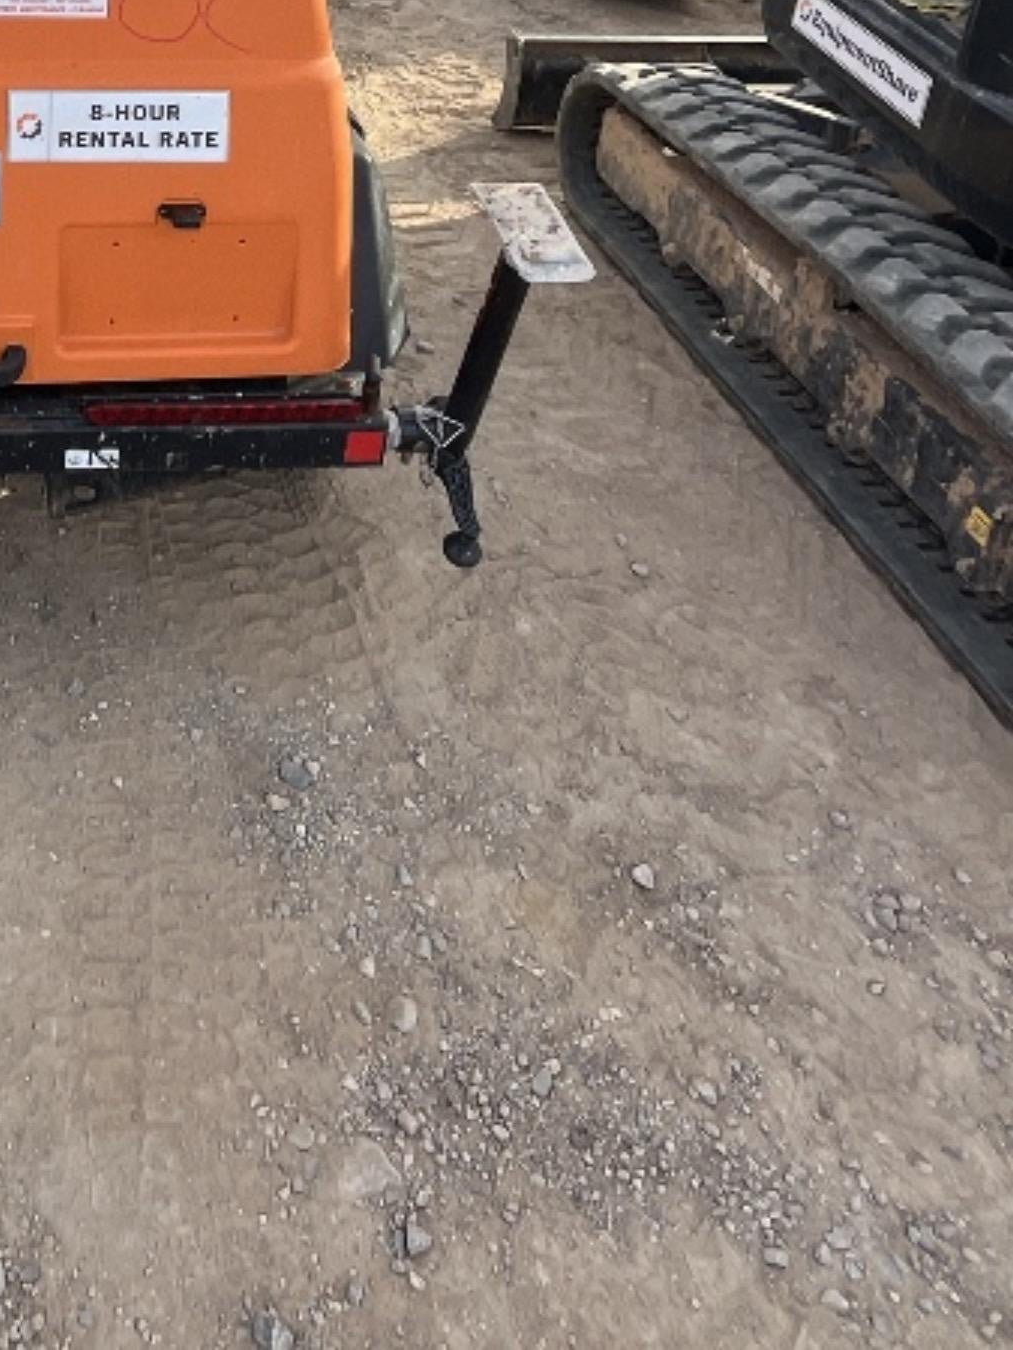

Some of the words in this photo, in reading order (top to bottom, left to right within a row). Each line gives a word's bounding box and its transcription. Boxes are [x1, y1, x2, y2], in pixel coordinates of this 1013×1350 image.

[88, 104, 181, 121] 8-HOUR
[58, 131, 150, 148] RENTAL
[159, 131, 220, 148] RATE
